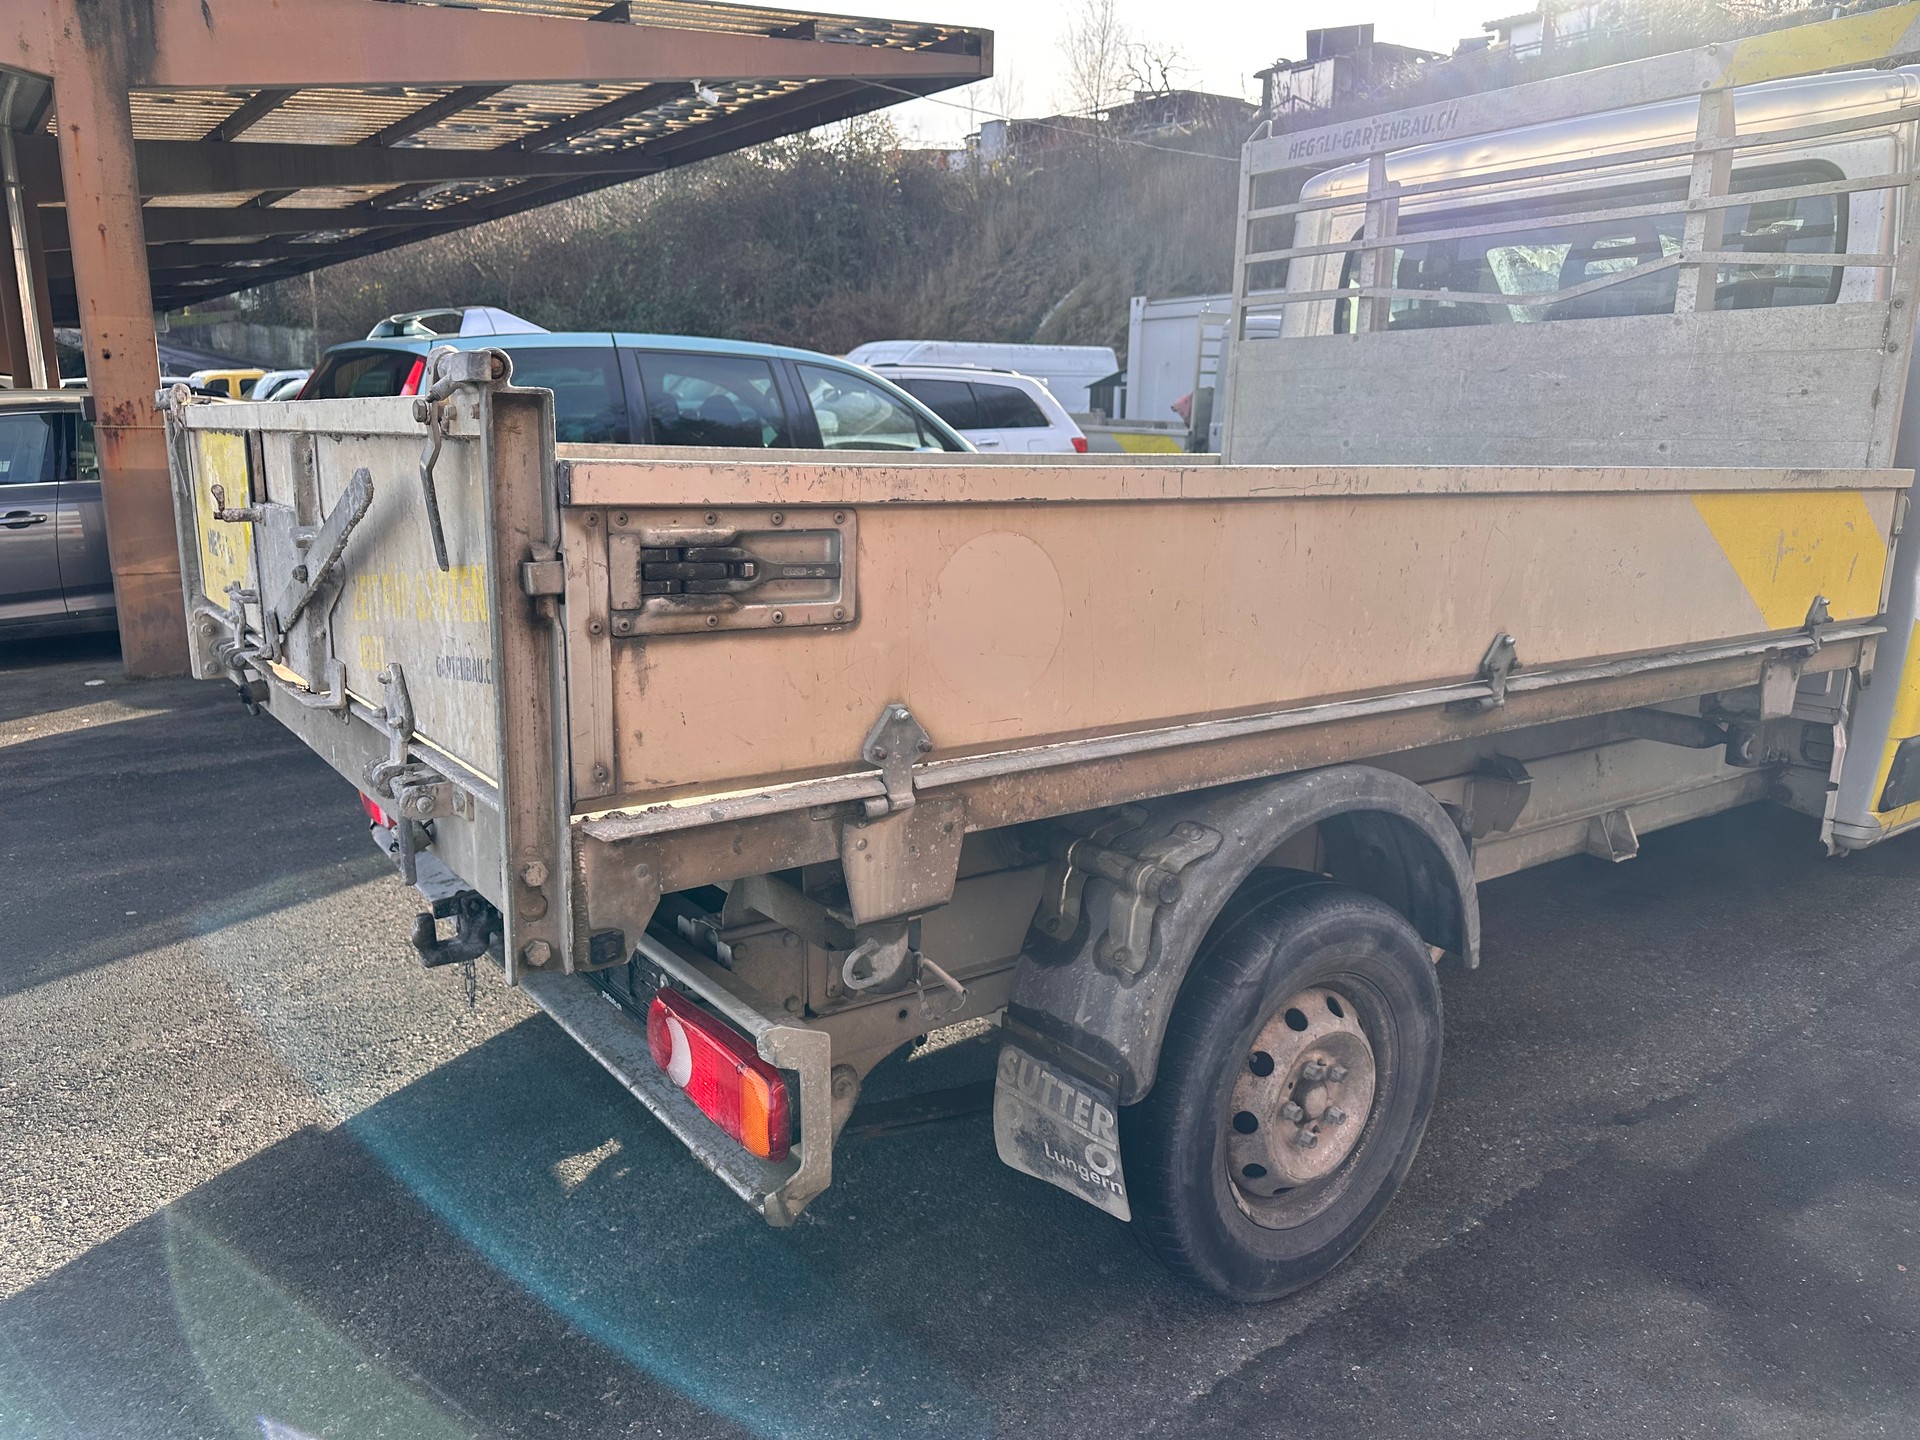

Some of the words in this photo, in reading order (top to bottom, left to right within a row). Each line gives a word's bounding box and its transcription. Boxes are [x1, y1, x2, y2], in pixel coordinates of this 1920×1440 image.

[1288, 109, 1459, 161] HEGGLI-GARTENBAU.CH
[999, 1050, 1115, 1141] SUTTER
[1043, 1141, 1124, 1195] Lungern
